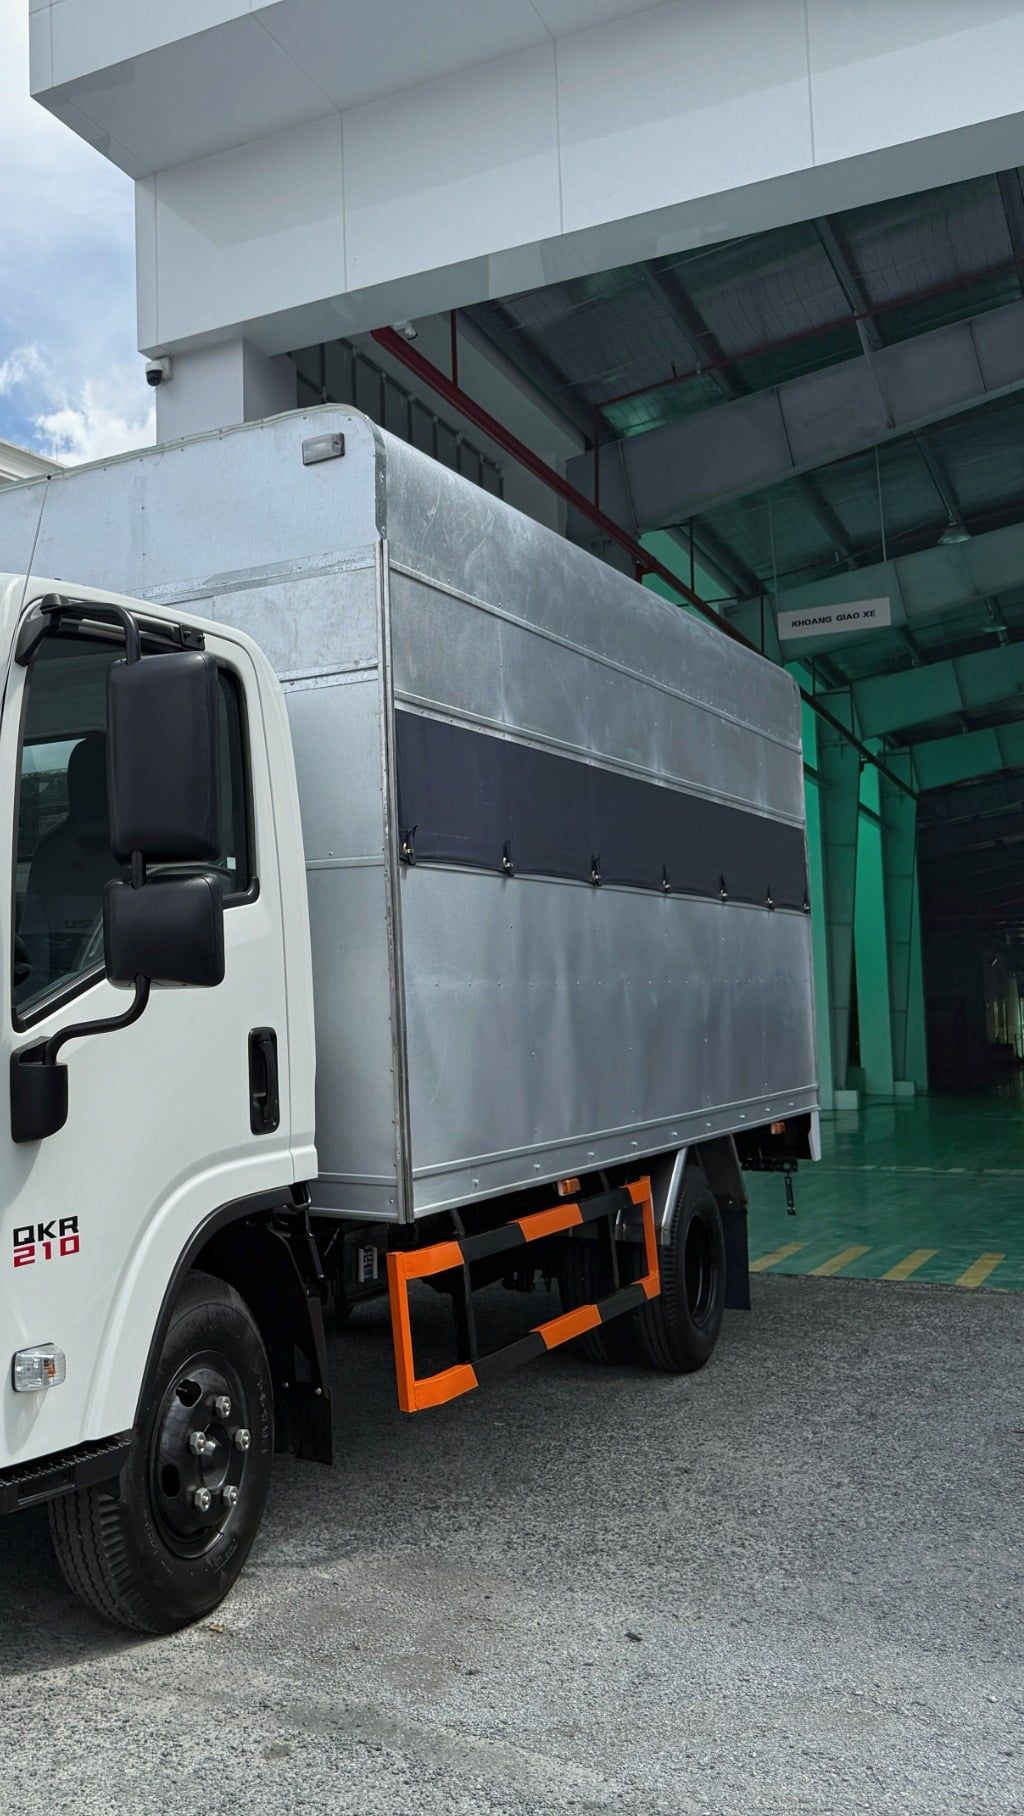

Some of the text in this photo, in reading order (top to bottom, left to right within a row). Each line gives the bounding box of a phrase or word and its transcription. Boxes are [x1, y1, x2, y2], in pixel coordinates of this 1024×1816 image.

[792, 610, 876, 627] KHOANG GIAO XE
[13, 1216, 79, 1247] QKR
[13, 1235, 80, 1268] 210
